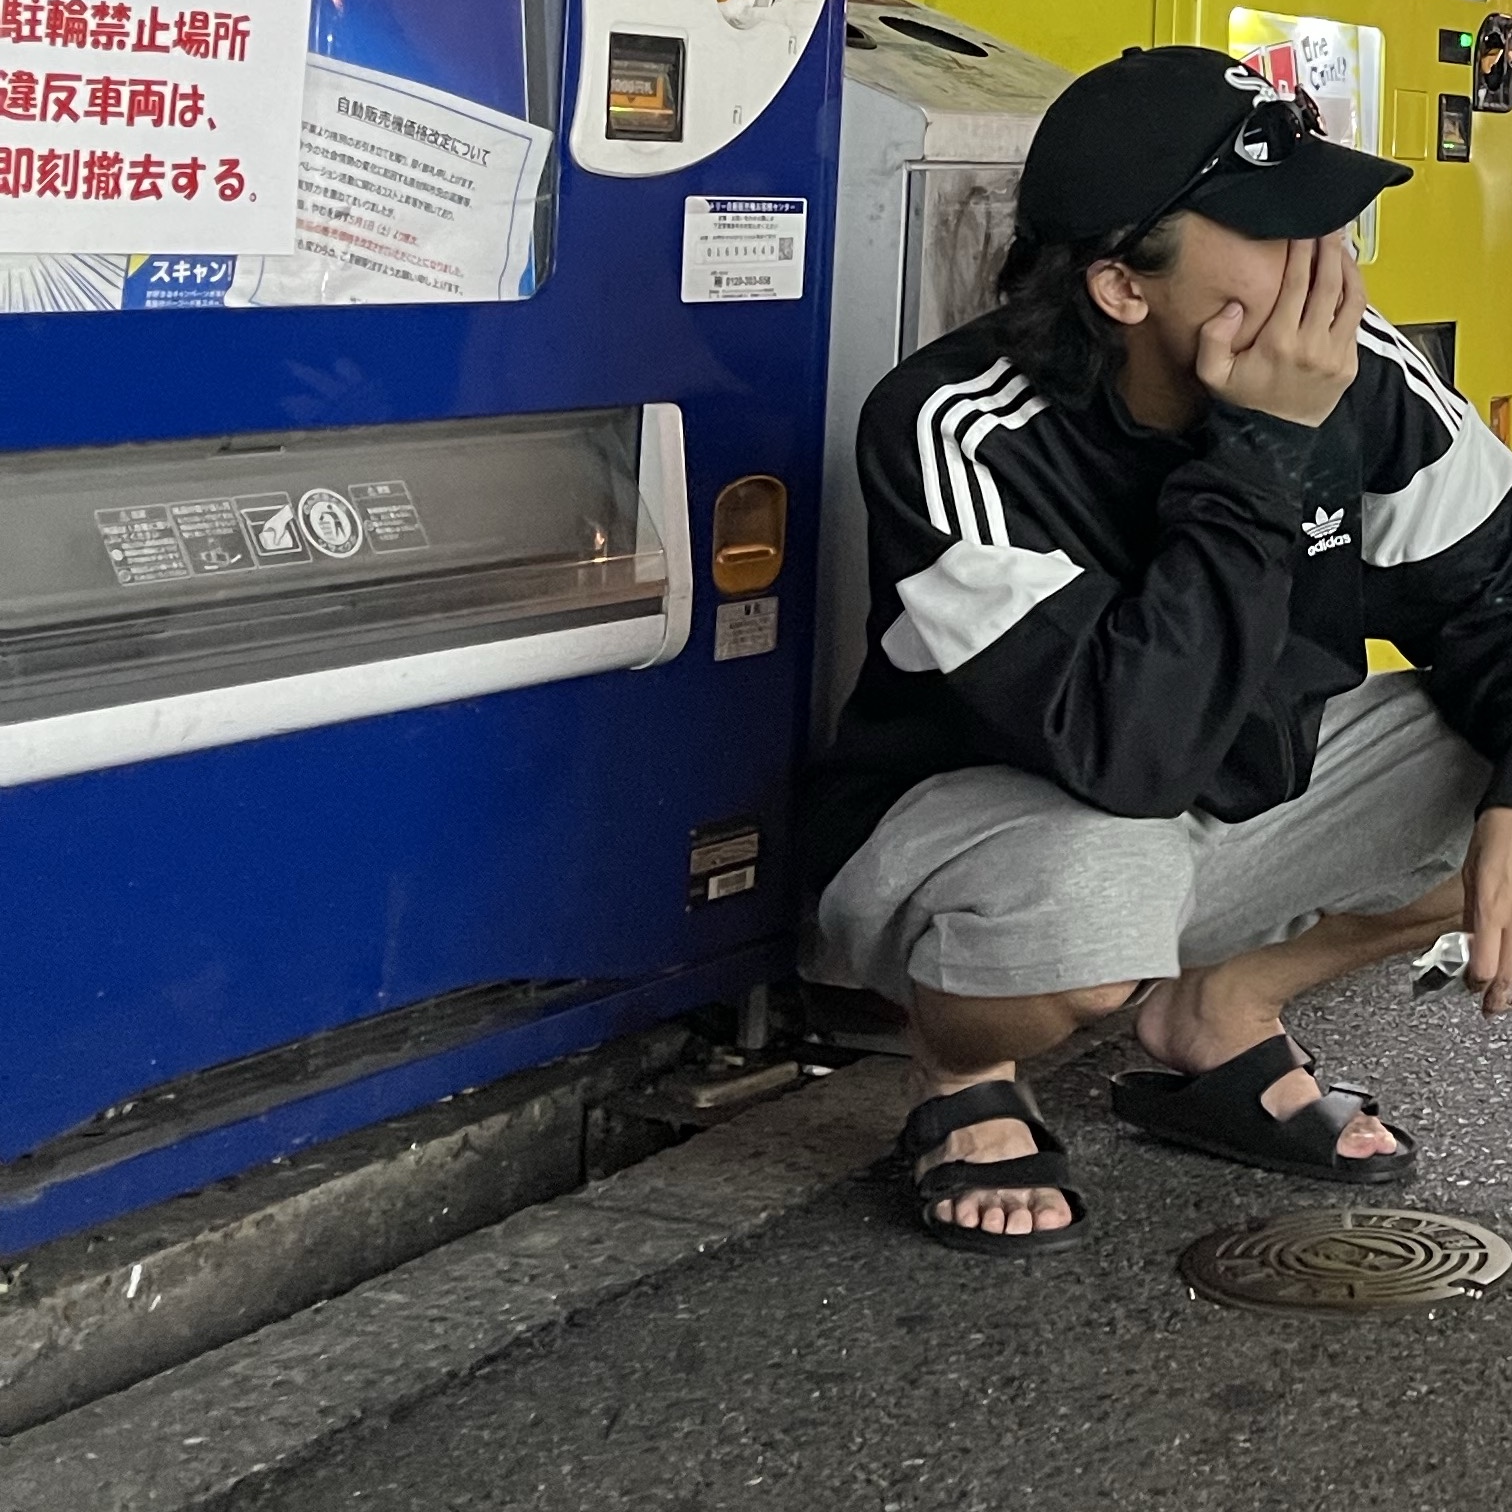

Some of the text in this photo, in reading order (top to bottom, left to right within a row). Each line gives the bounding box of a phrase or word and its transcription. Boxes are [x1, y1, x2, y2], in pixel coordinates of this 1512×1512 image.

[0, 69, 217, 130] 違反車両は、
[0, 146, 257, 203] 即刻撤去する。
[1307, 533, 1352, 557] adidas
